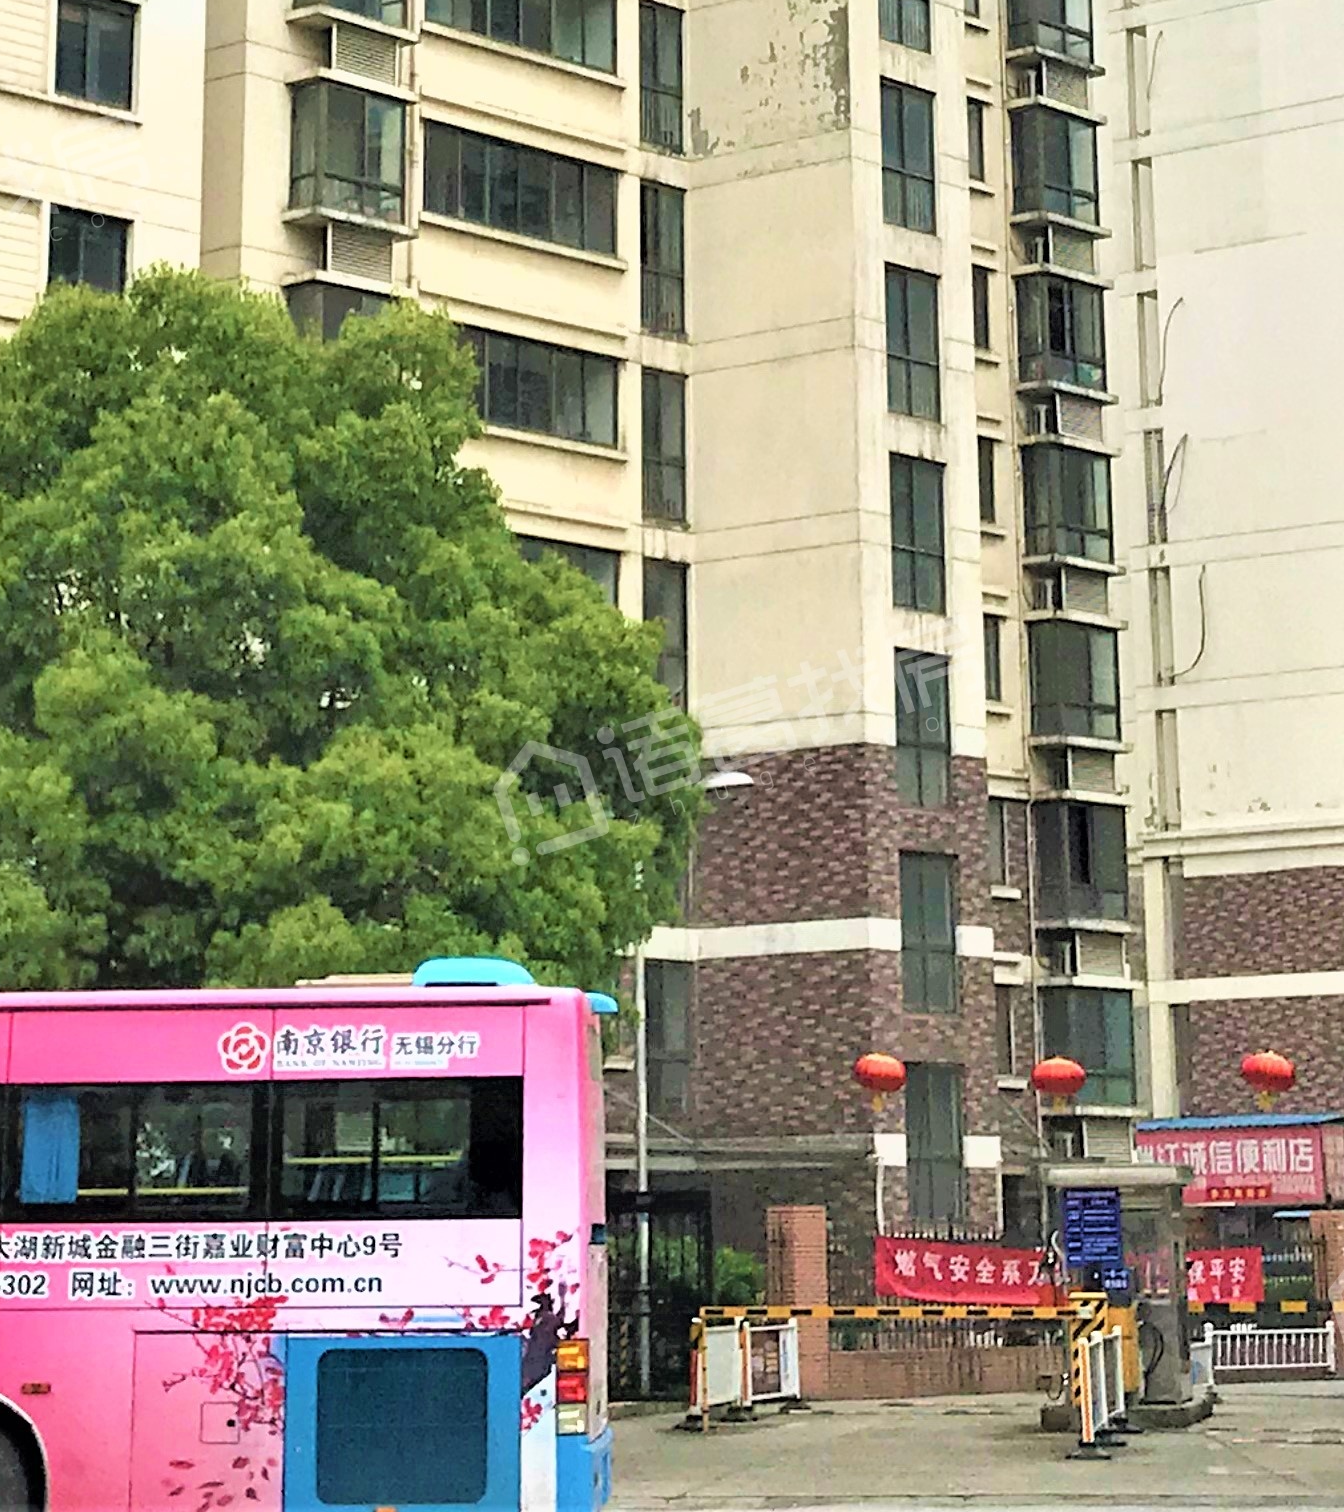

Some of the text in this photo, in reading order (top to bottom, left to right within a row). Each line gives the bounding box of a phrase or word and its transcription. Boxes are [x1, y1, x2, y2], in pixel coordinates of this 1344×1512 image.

[276, 1028, 478, 1056] 南京银行 无锡分行
